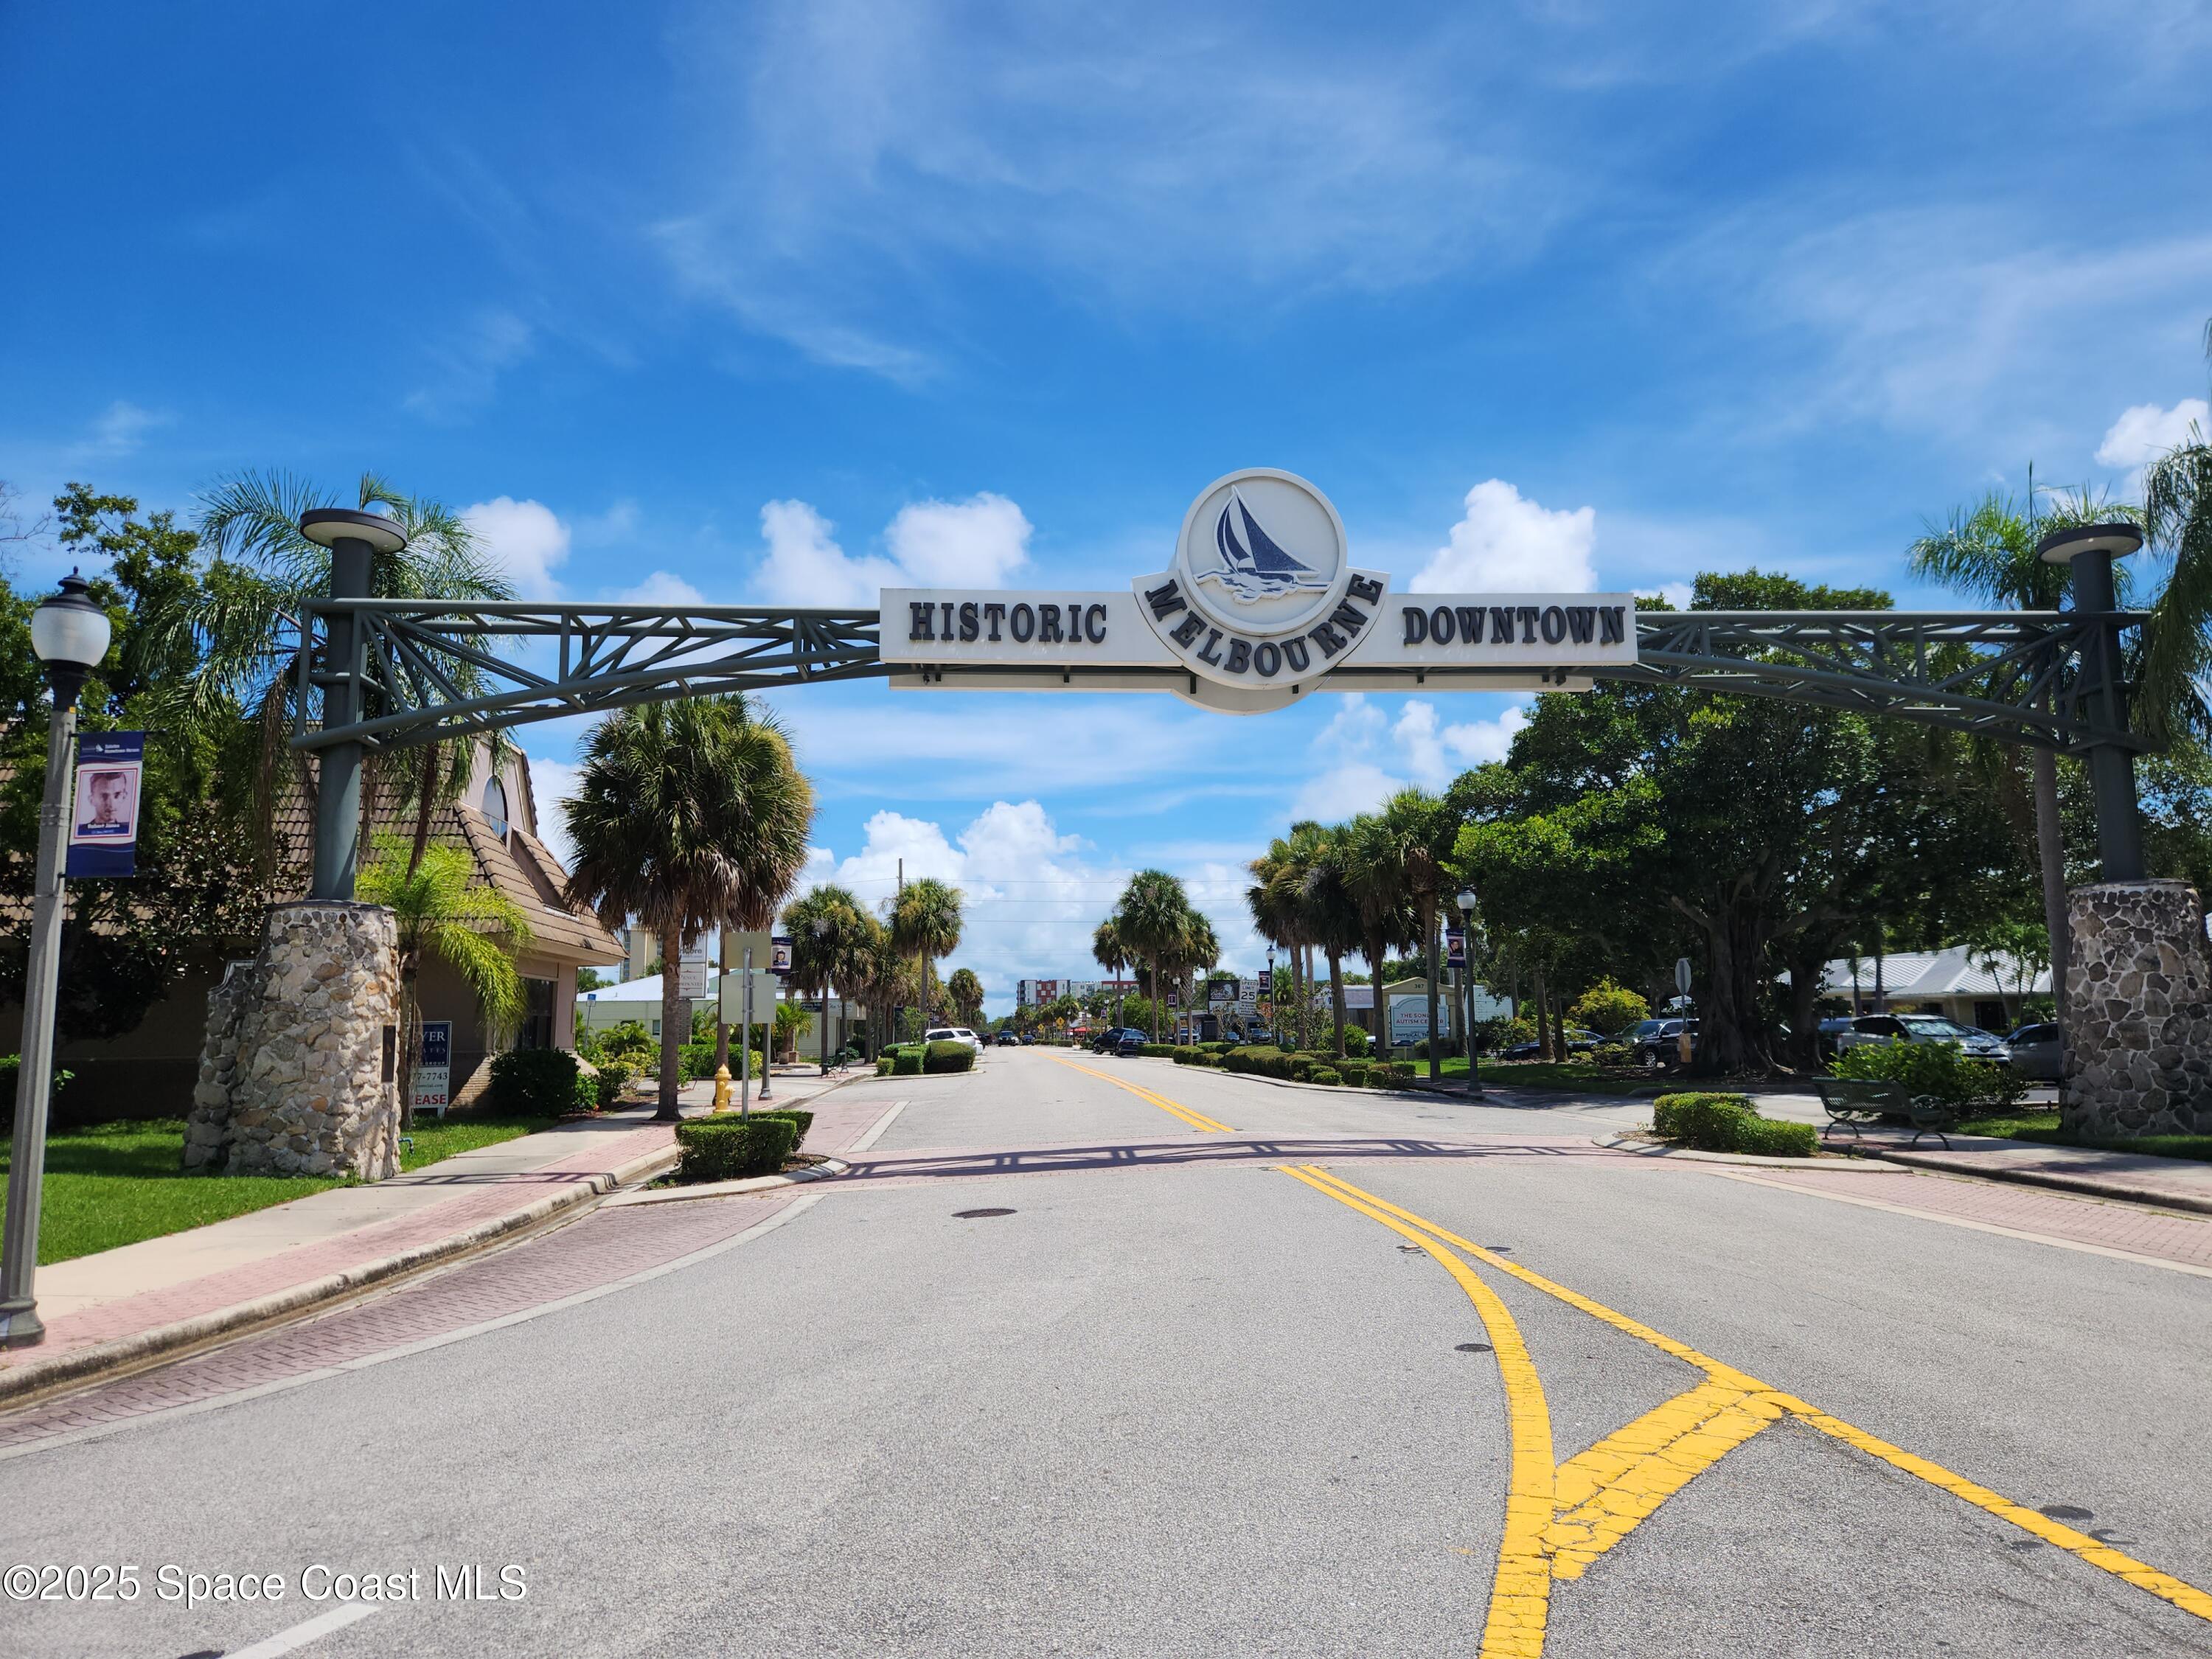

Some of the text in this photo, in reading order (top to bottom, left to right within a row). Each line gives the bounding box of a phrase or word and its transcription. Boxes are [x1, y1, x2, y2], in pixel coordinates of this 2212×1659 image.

[908, 602, 1107, 644] HISTORIC
[1145, 574, 1384, 678] MELBOURNE
[1402, 605, 1627, 646] DOWNTOWN
[1241, 991, 1256, 1001] 25
[421, 1032, 445, 1042] YER
[415, 1095, 446, 1105] EASE
